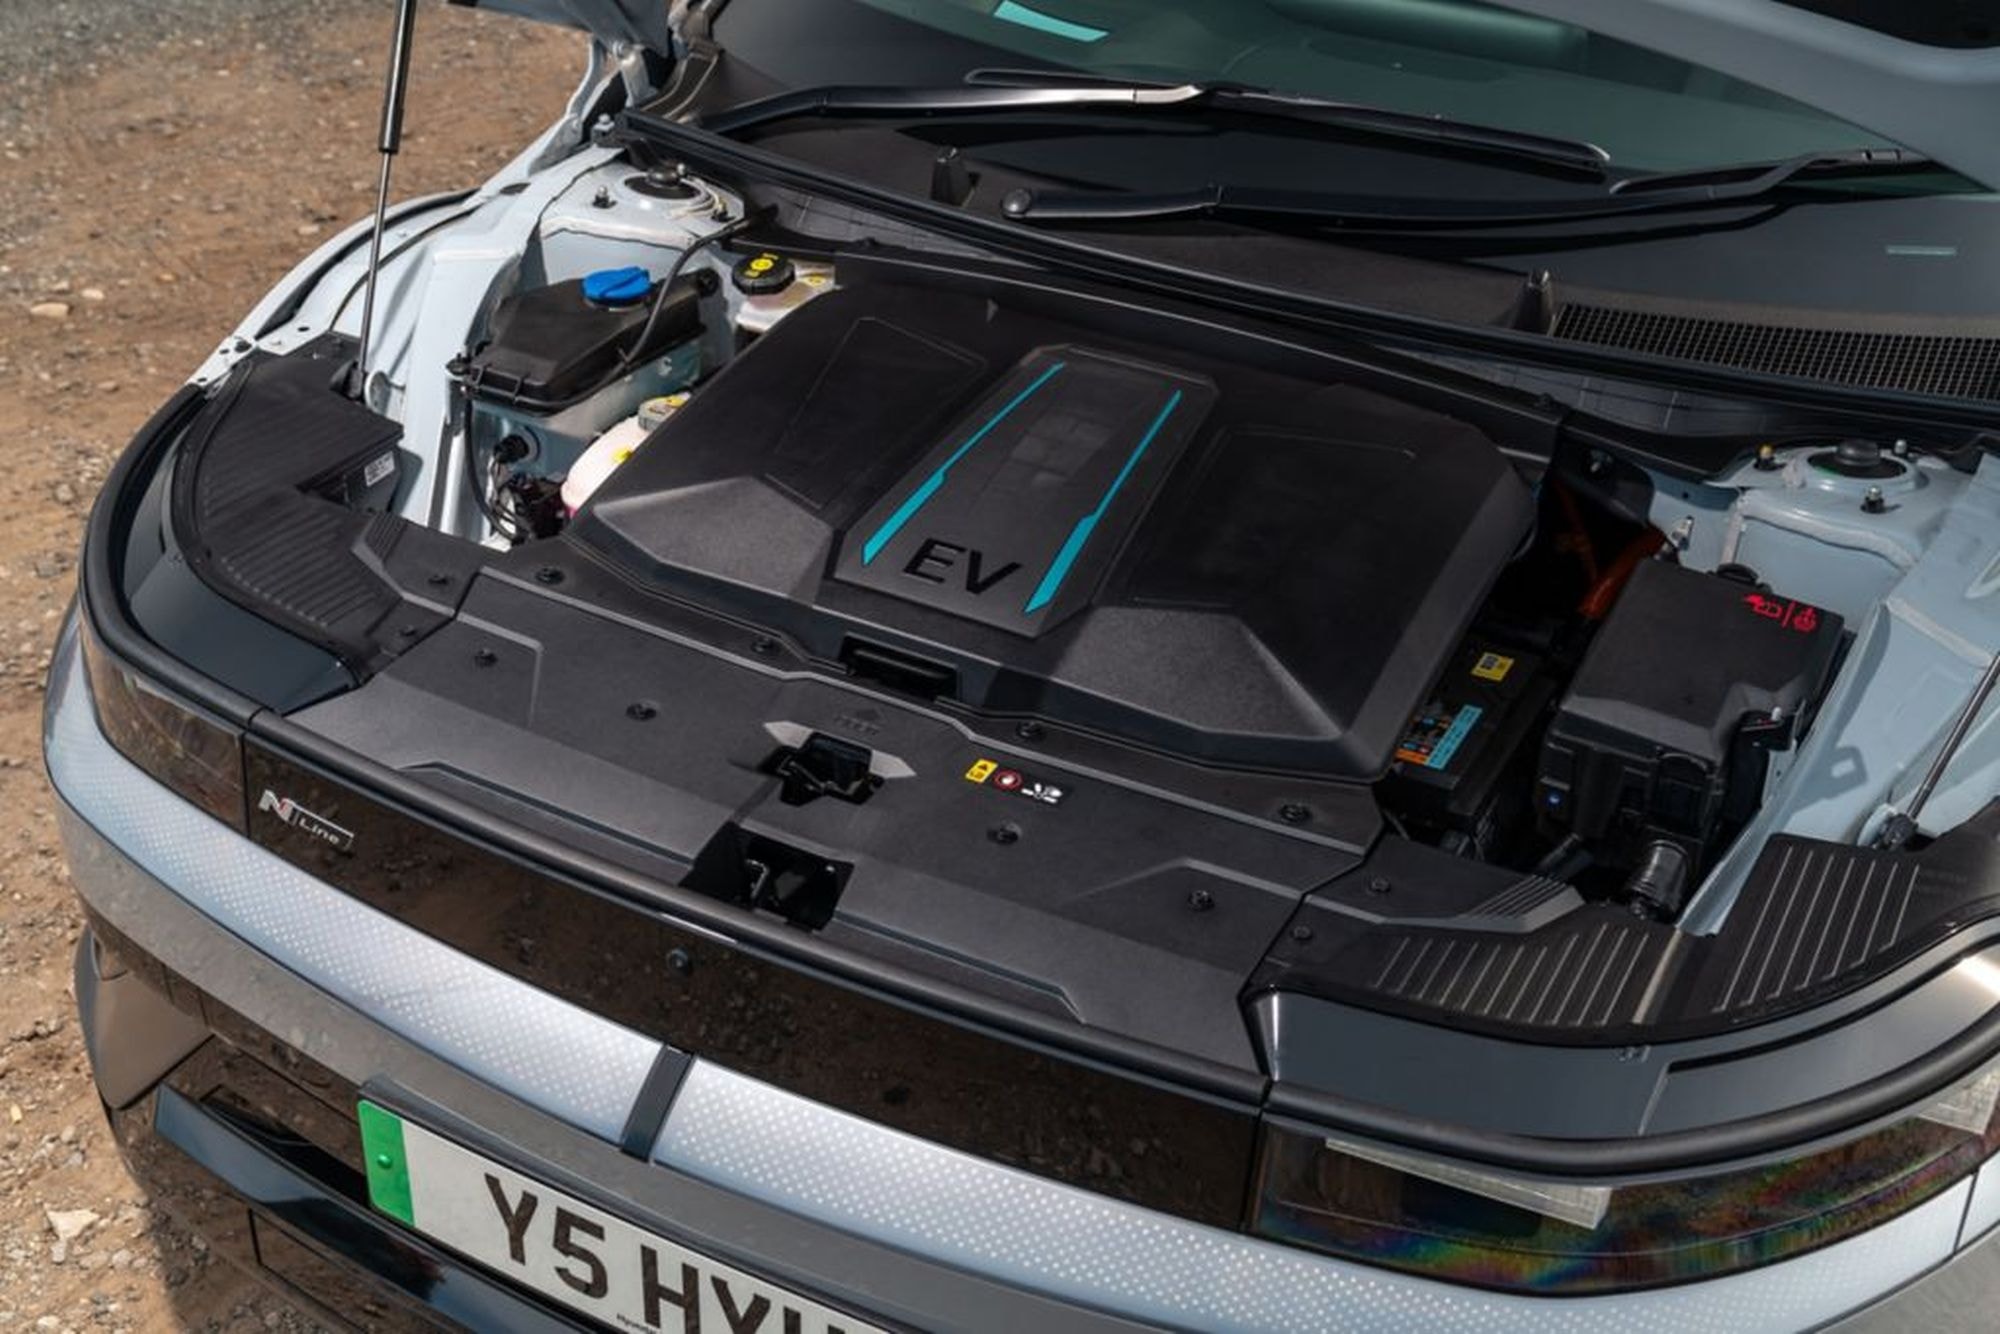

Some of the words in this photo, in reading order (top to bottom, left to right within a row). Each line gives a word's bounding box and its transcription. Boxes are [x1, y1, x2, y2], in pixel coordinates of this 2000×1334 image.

[903, 538, 1023, 594] EV
[258, 789, 294, 822] N
[299, 818, 340, 845] Line
[484, 1172, 609, 1300] Y5
